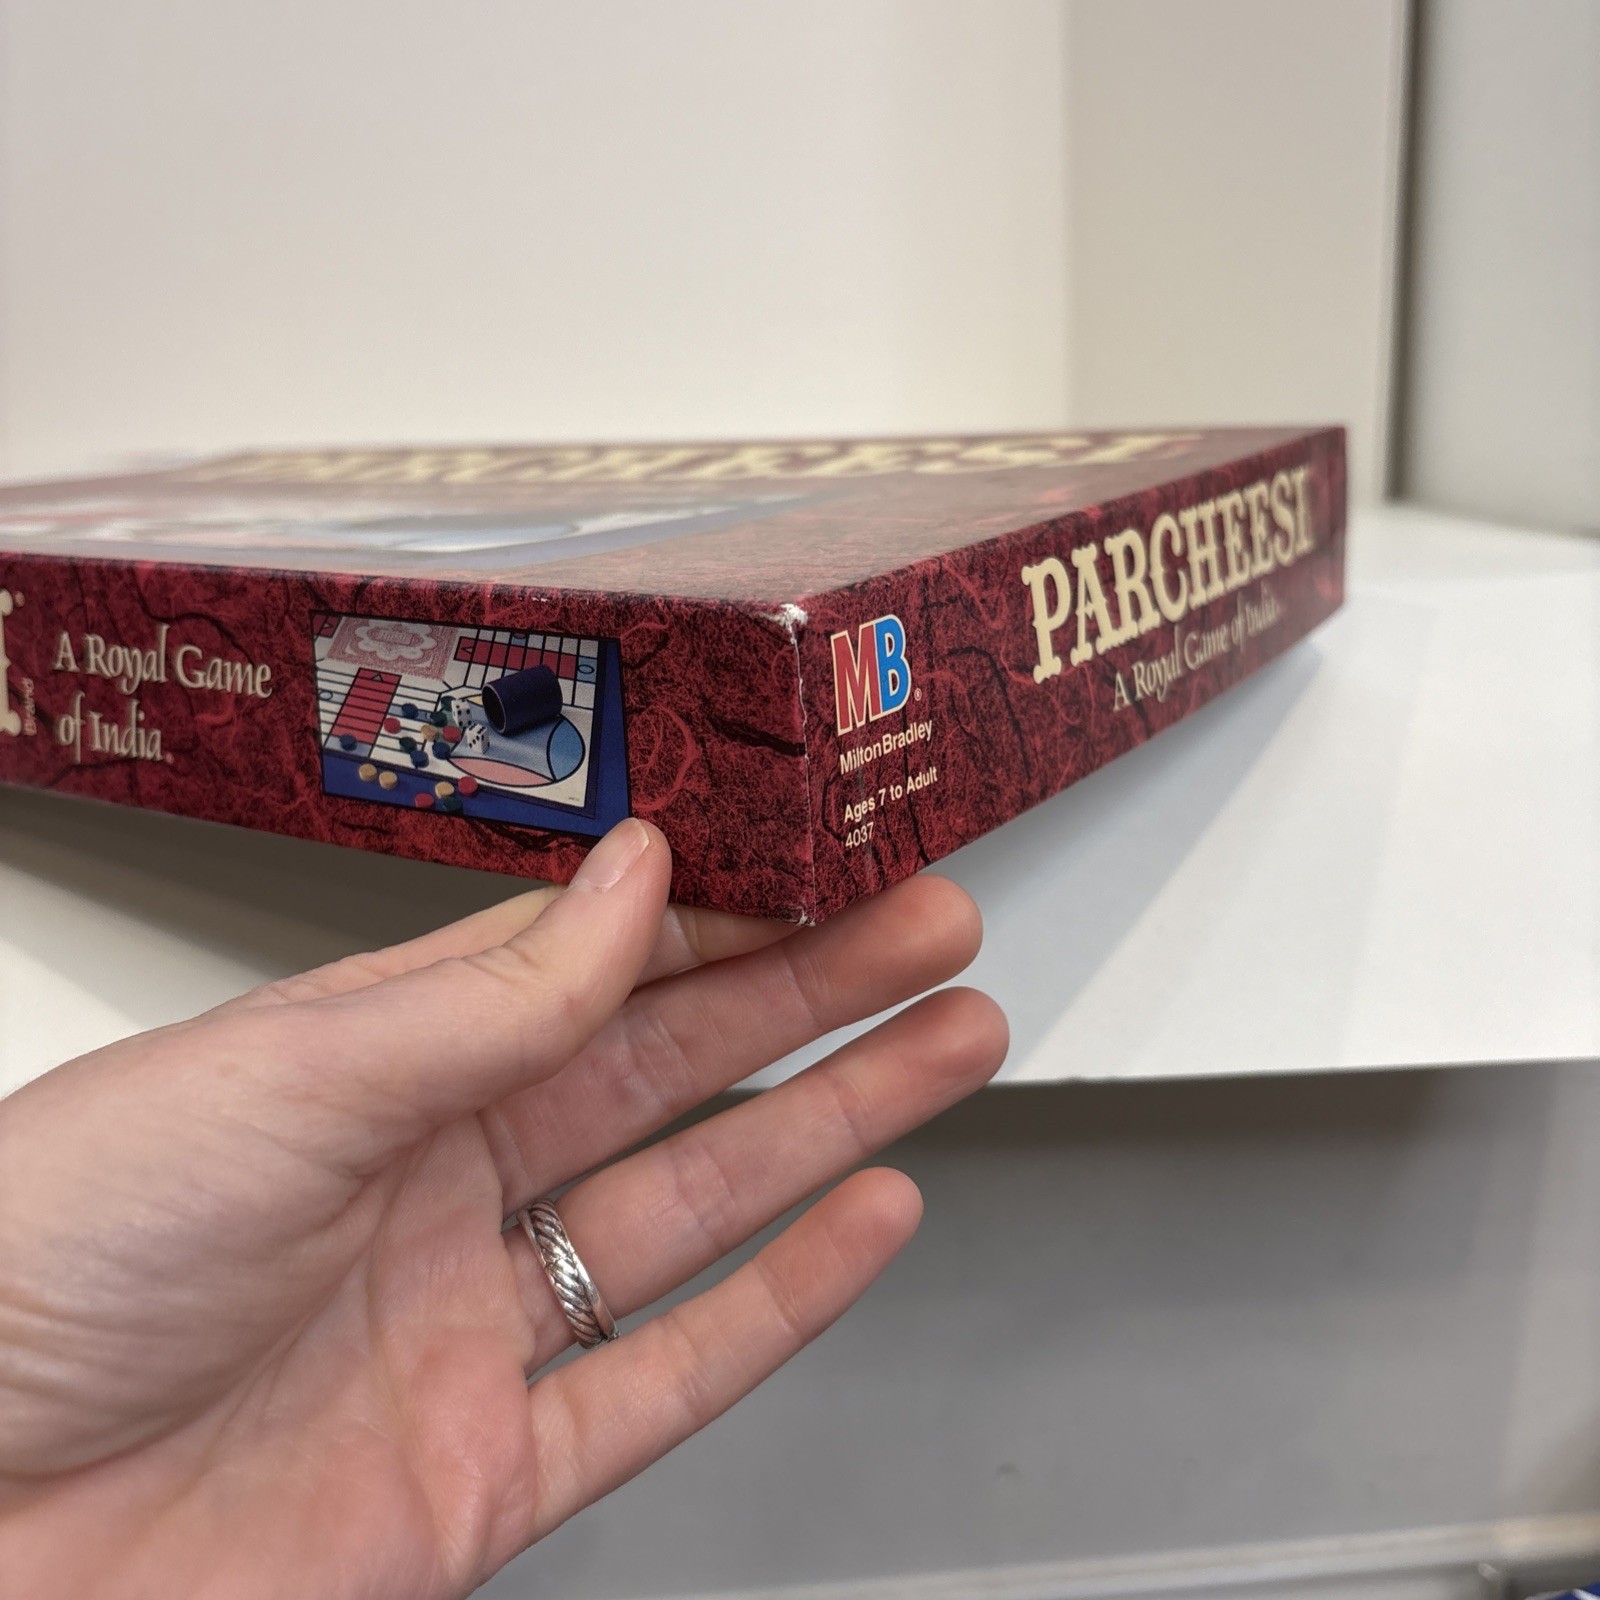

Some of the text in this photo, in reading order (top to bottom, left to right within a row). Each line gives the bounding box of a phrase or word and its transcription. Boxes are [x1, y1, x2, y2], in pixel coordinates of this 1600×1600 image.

[1022, 465, 1314, 684] PARCHEESI
[53, 623, 273, 698] A Royal Game
[830, 614, 912, 736] MB
[1112, 671, 1132, 713] A
[1132, 624, 1182, 703] Royal
[1184, 623, 1229, 671] Game
[58, 690, 85, 764] of
[844, 766, 938, 823] Ages 7 to Adult
[845, 822, 875, 849] 4037
